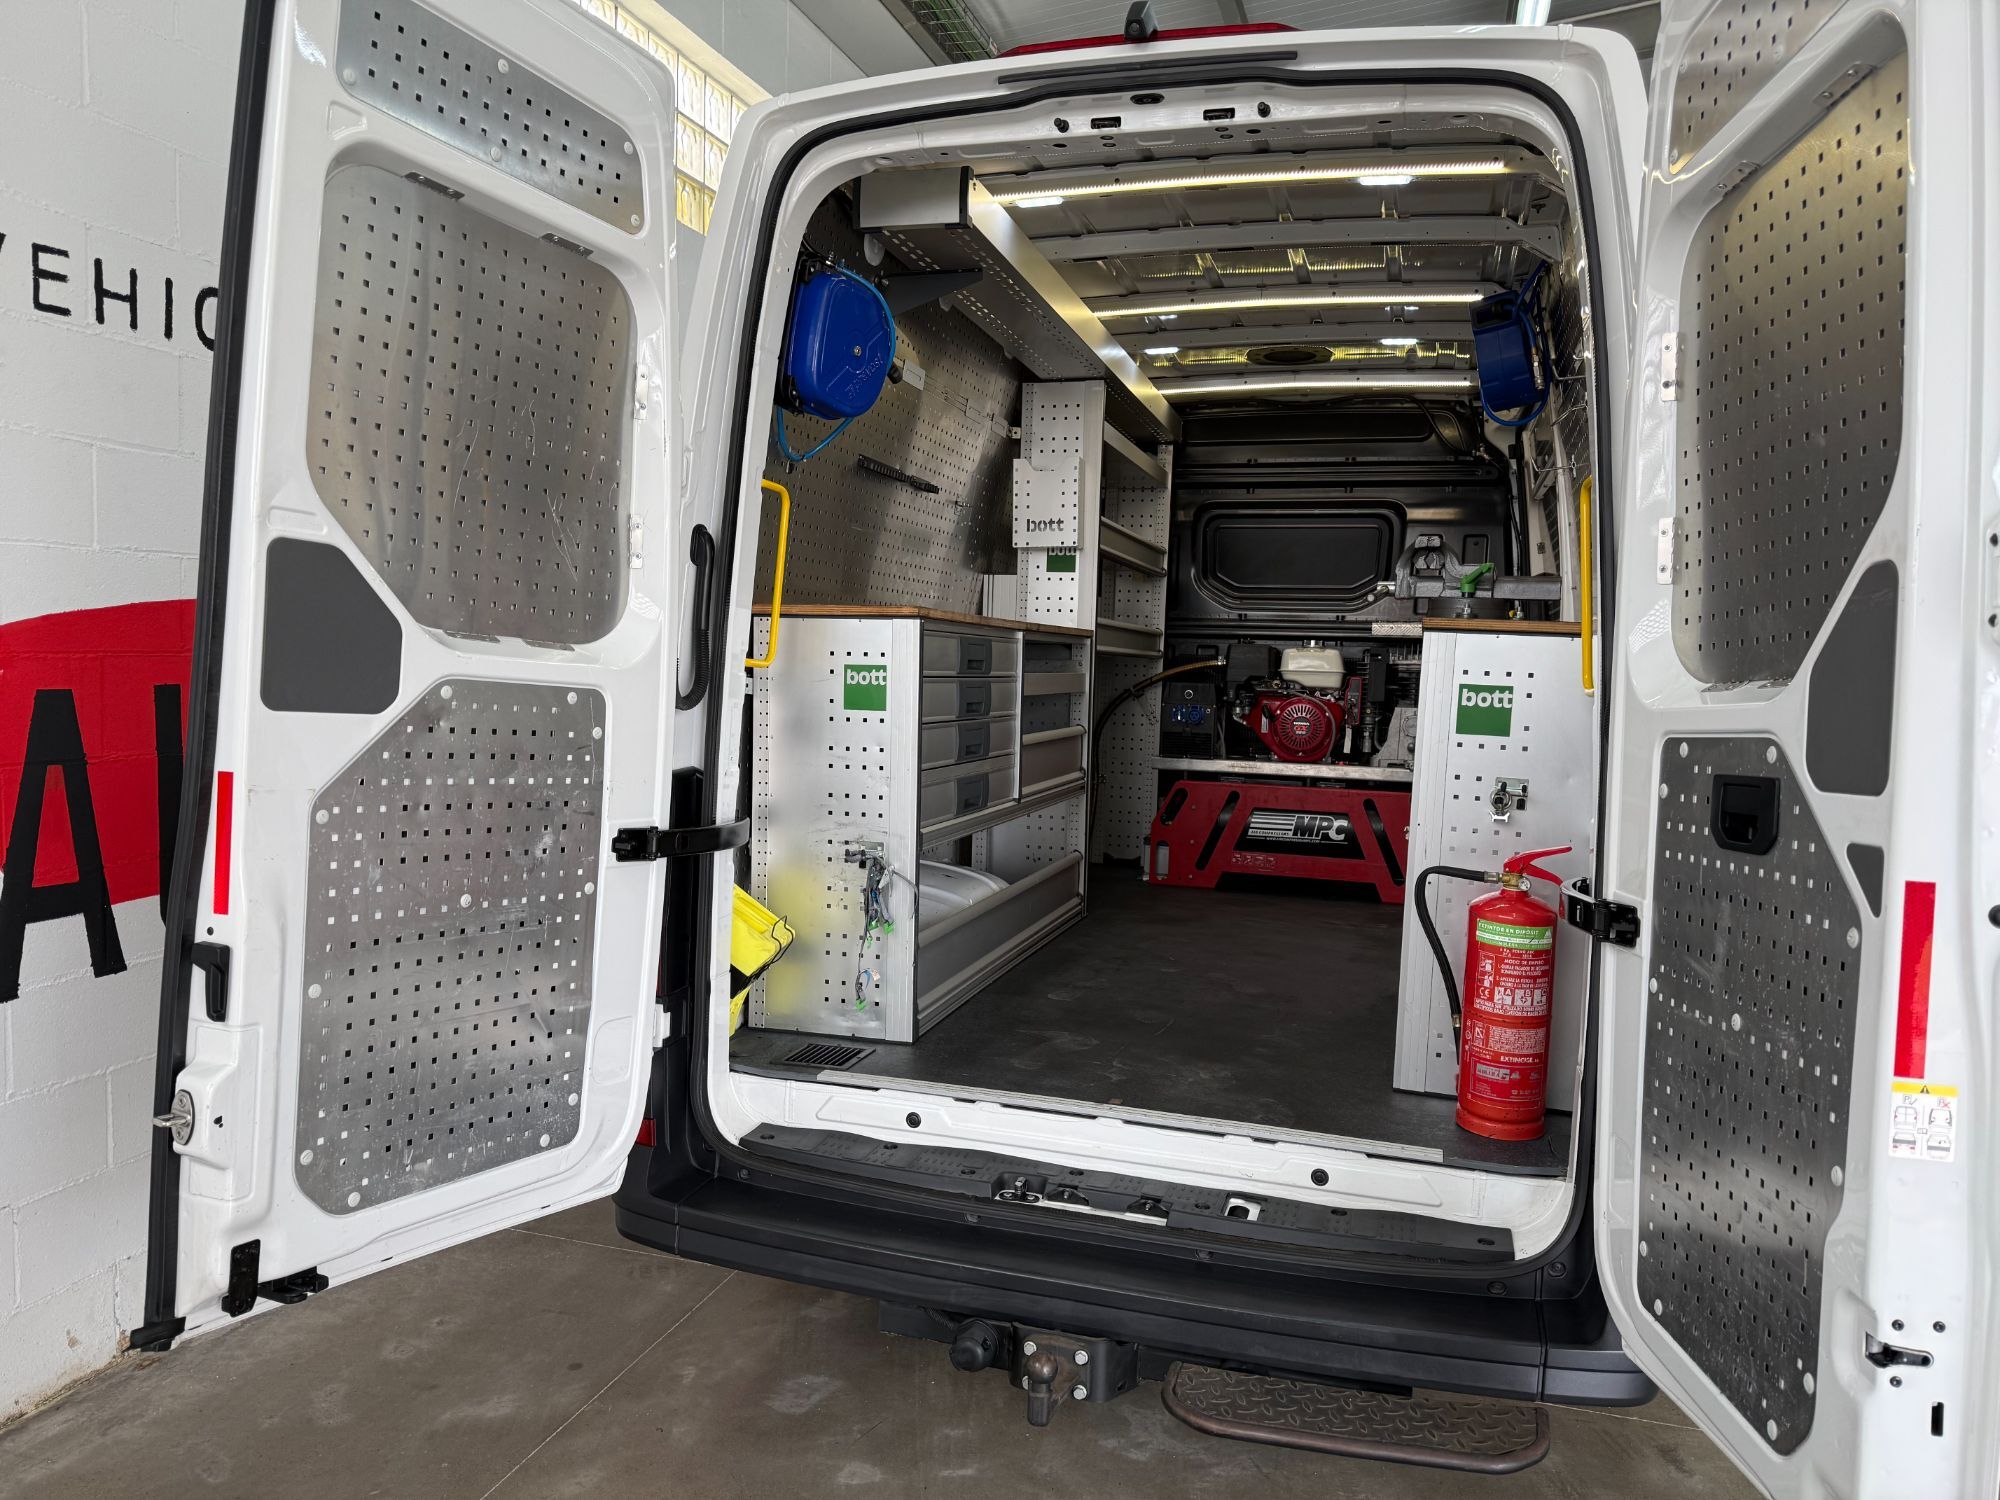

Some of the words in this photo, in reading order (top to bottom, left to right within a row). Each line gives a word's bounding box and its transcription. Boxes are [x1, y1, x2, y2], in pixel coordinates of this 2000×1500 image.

[1026, 518, 1064, 532] bott
[846, 668, 887, 686] bott
[1461, 688, 1513, 709] bott
[1292, 814, 1349, 841] MPC
